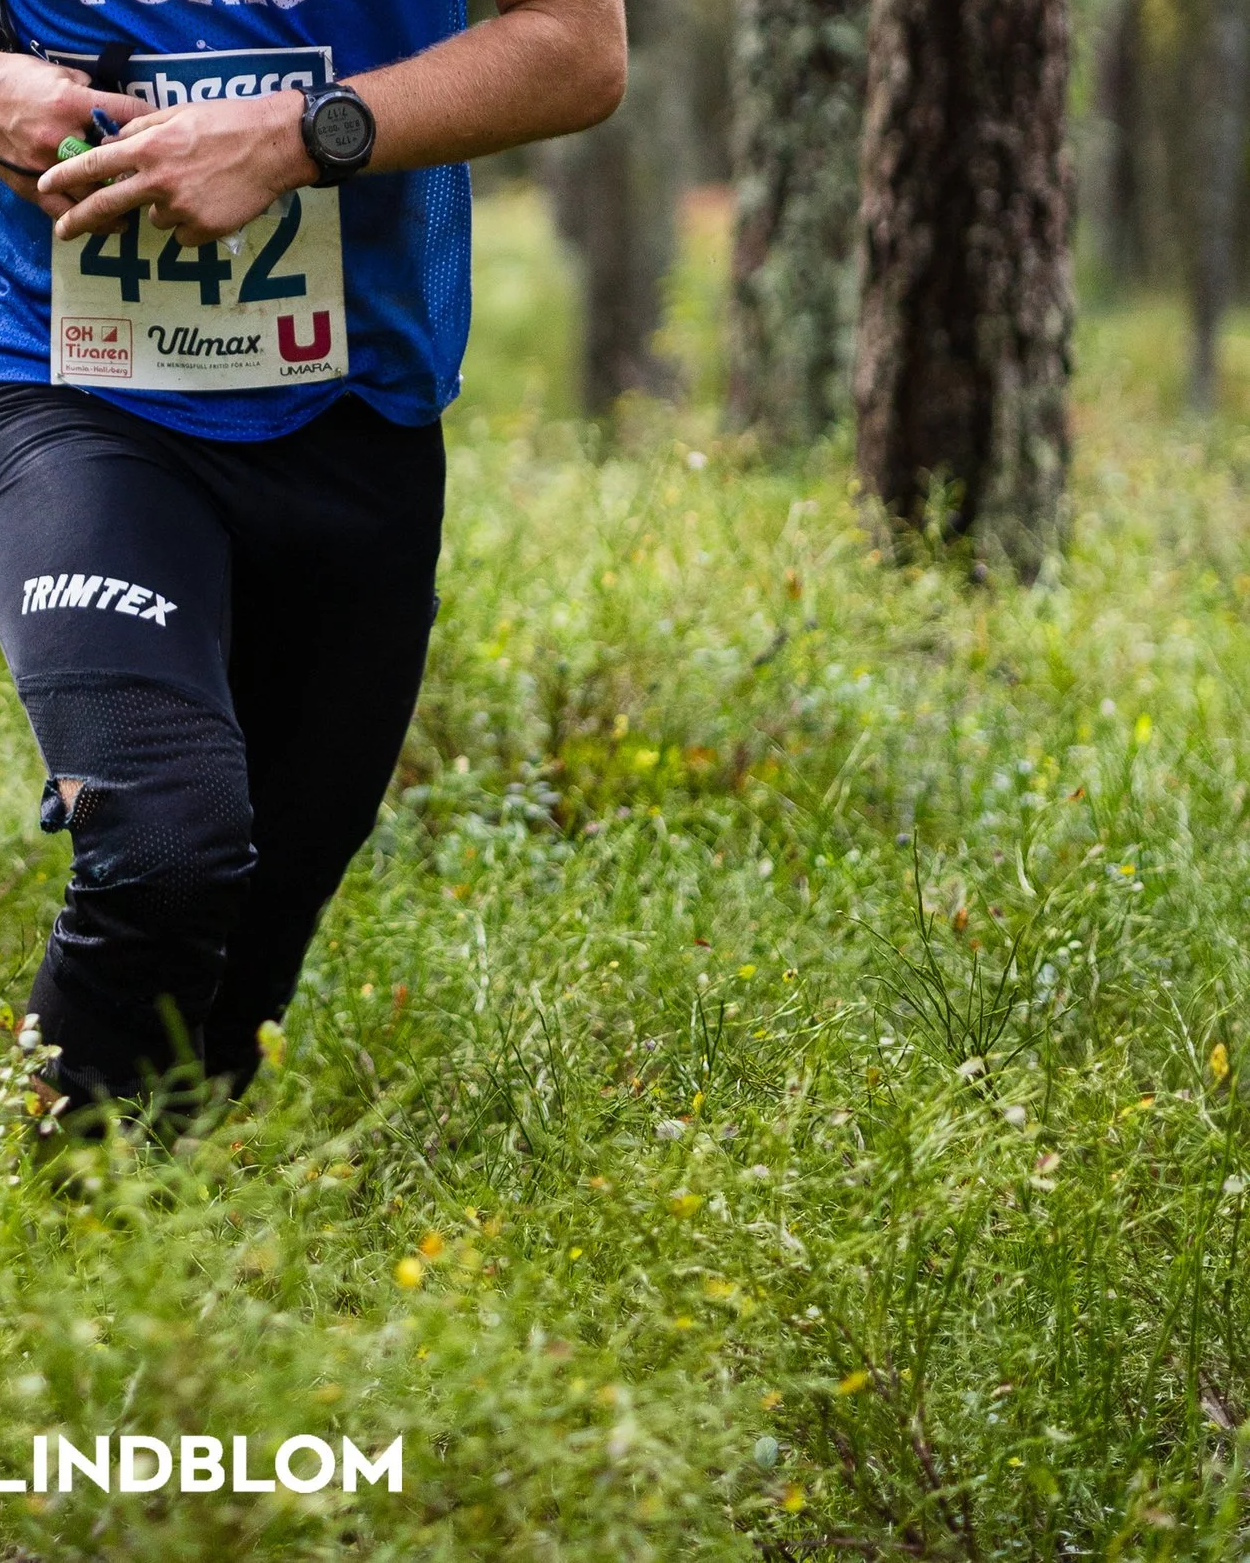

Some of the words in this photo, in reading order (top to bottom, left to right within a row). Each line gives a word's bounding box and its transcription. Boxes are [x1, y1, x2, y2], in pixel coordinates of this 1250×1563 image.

[80, 190, 307, 305] 442
[65, 343, 129, 360] Tisaren
[148, 325, 261, 356] Ullmax
[279, 362, 332, 377] UMARA
[21, 573, 179, 627] TRIMTEX
